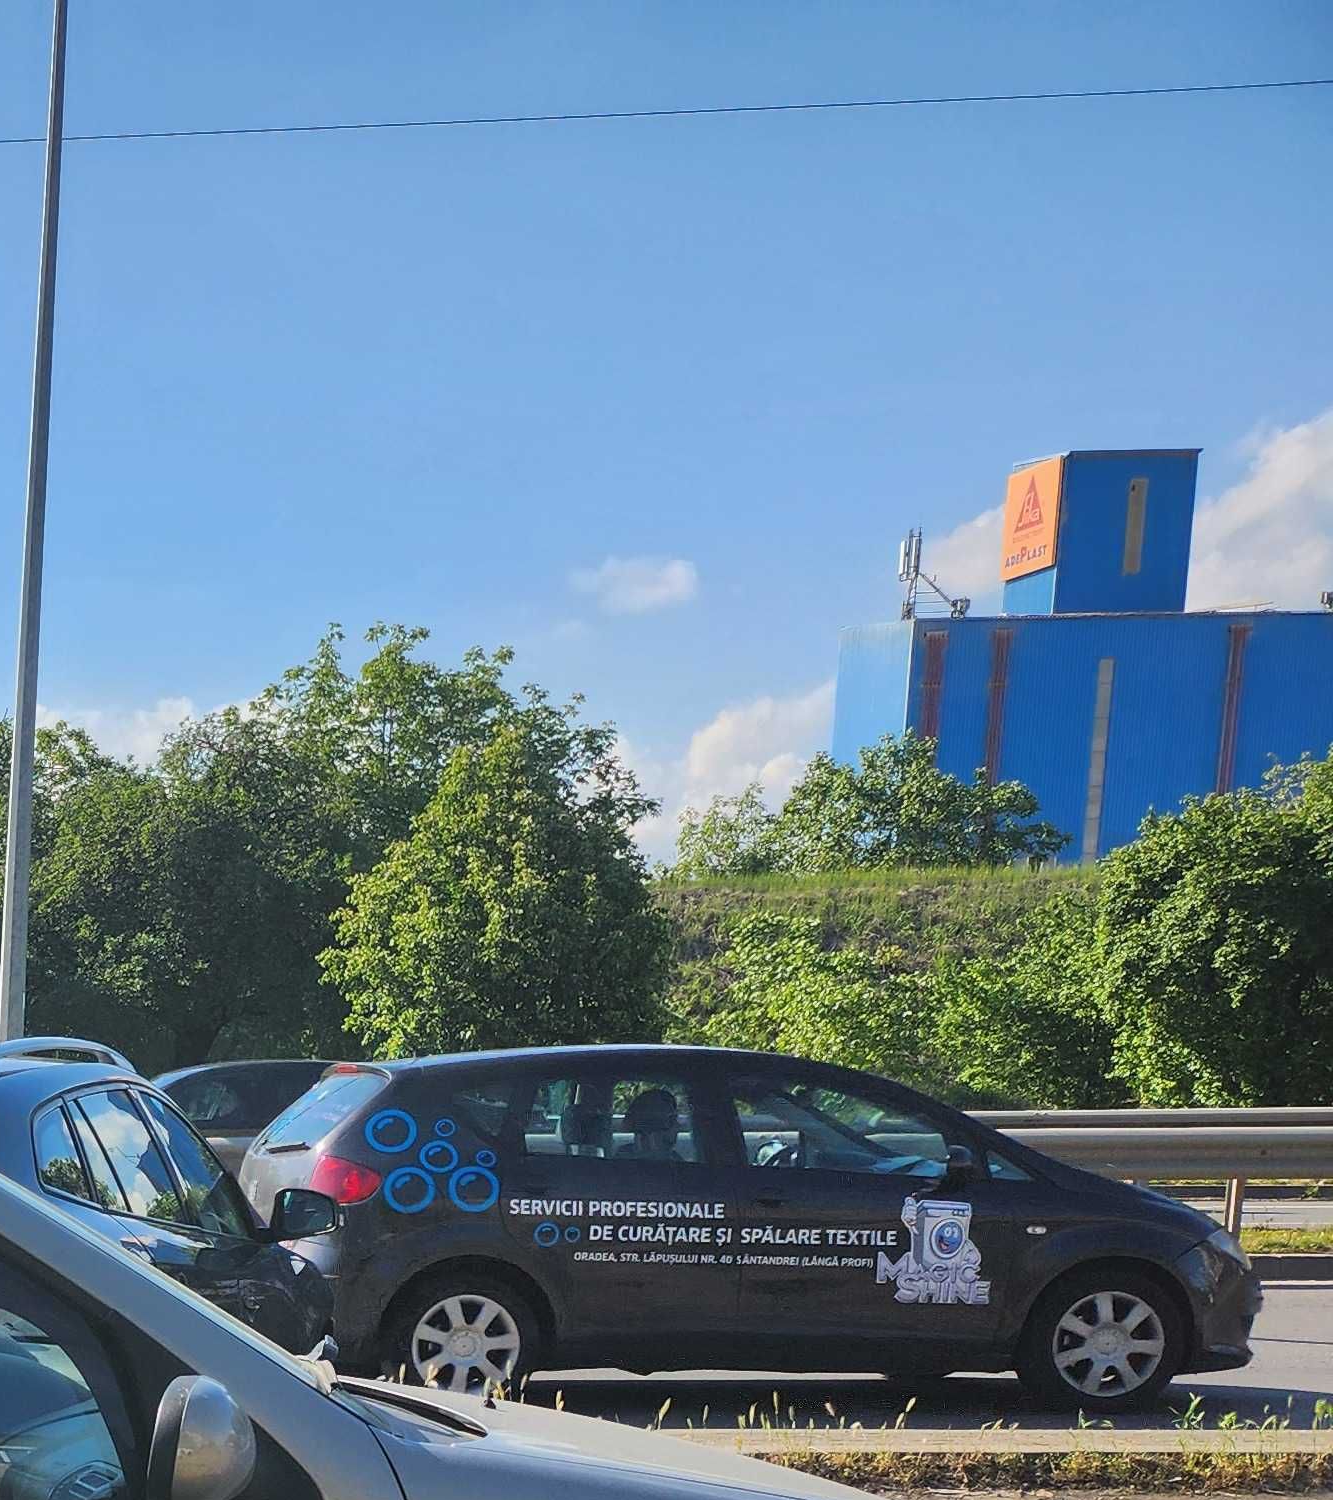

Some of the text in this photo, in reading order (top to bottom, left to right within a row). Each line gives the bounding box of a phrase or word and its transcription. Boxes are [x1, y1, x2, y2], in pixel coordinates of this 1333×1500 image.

[509, 1198, 726, 1219] SERVICII PROFESIONALE
[589, 1225, 614, 1241] DE
[740, 1225, 822, 1245] SPĂLARE
[826, 1229, 898, 1246] TEXTILE
[573, 1251, 617, 1263] ORADEA,
[620, 1252, 640, 1263] STR.
[700, 1254, 718, 1265] NR.
[719, 1254, 733, 1264] 40
[841, 1257, 874, 1269] PROFI)
[876, 1251, 982, 1284] MAGIC
[893, 1273, 992, 1305] SHINE
